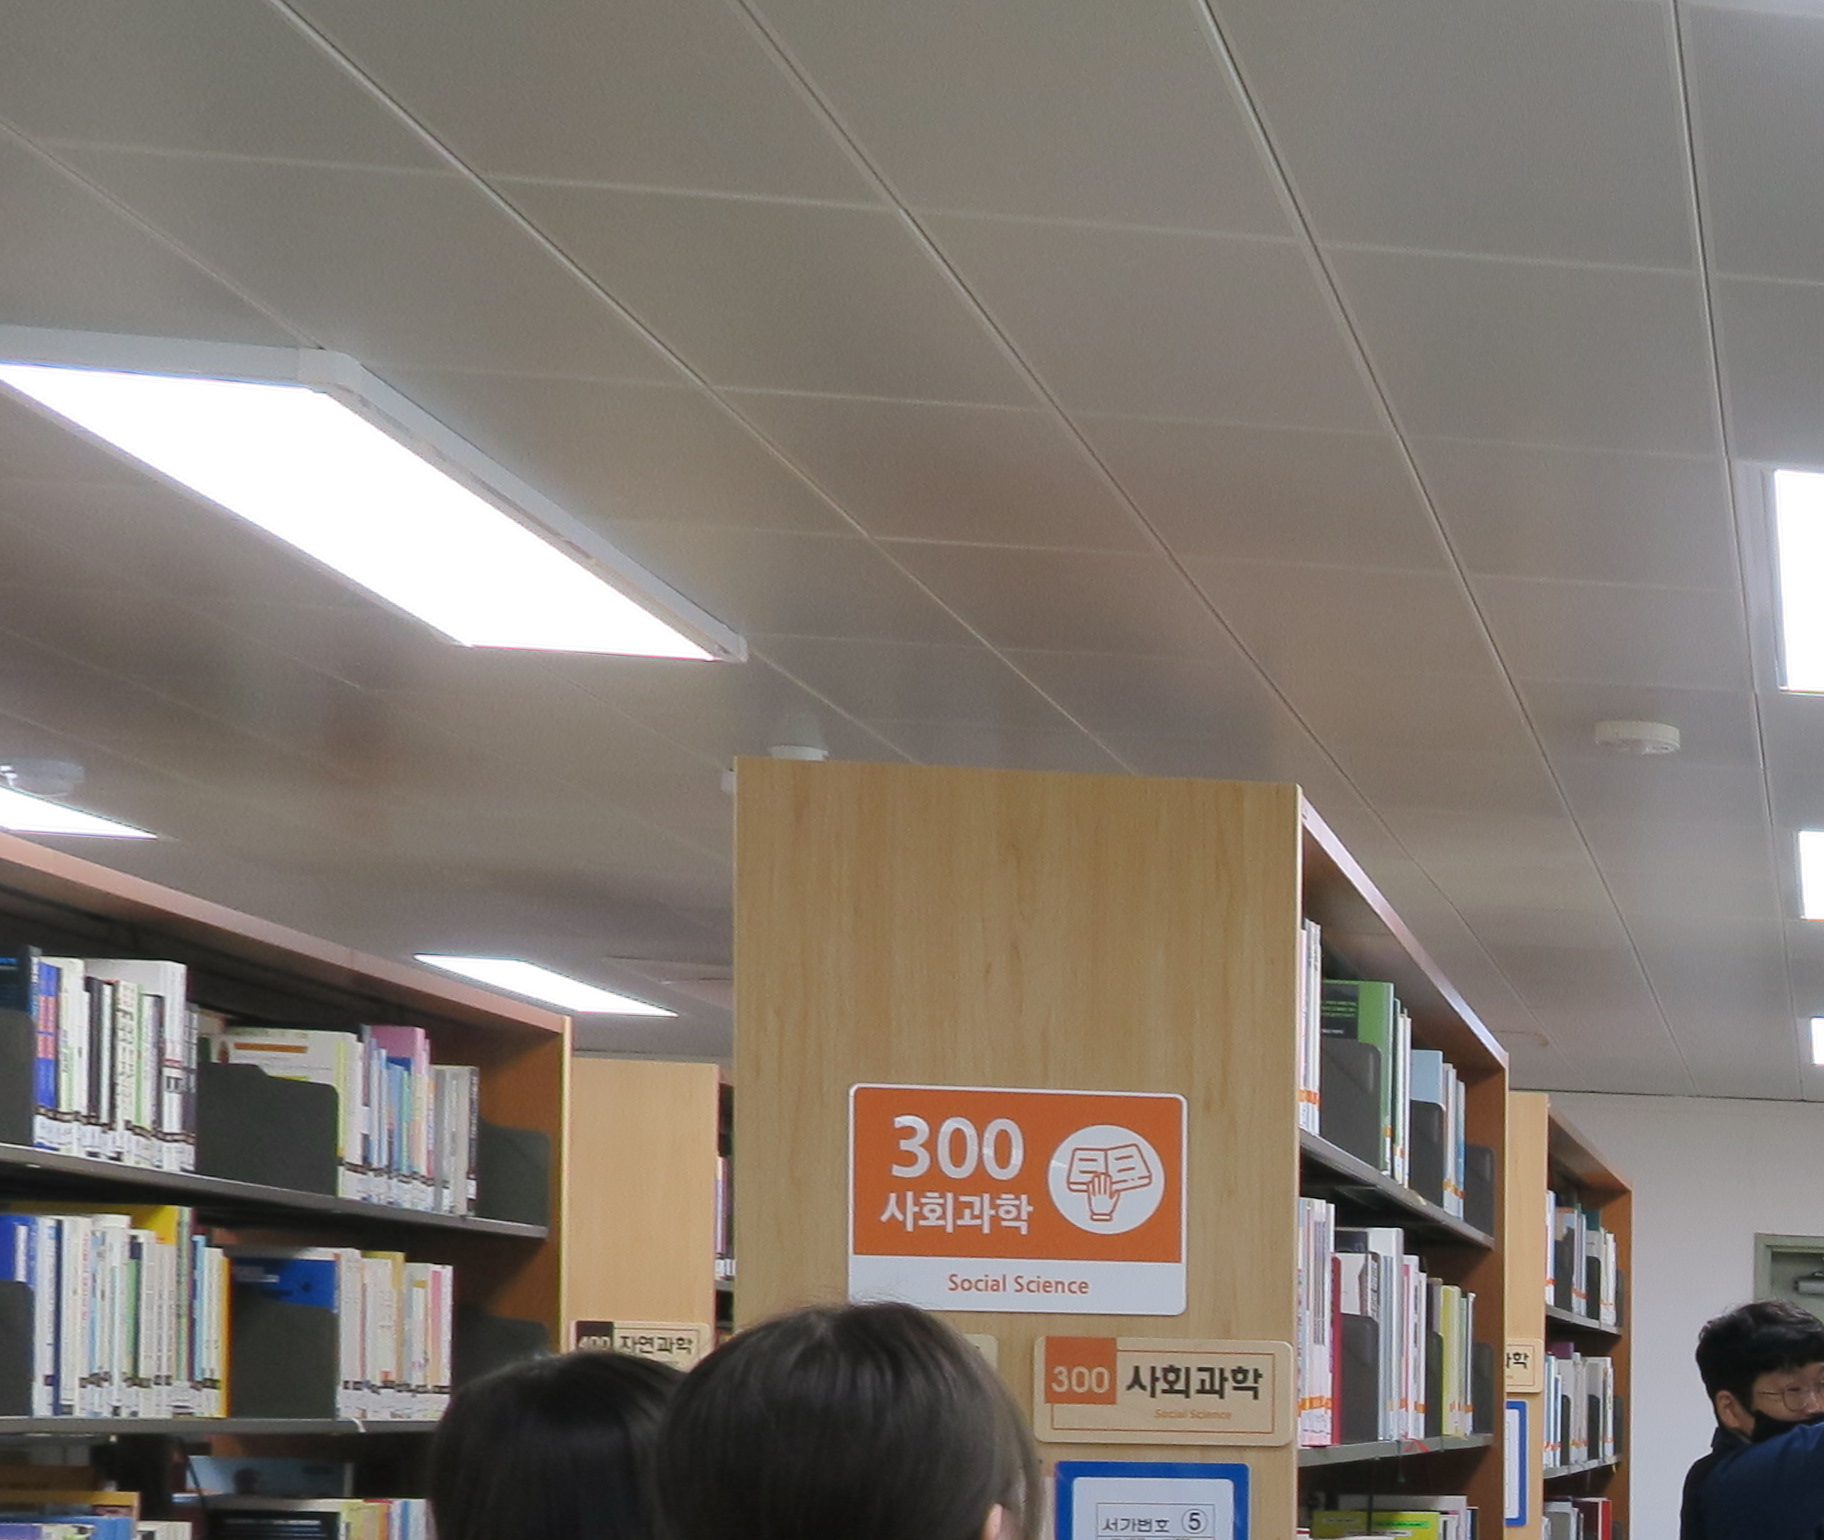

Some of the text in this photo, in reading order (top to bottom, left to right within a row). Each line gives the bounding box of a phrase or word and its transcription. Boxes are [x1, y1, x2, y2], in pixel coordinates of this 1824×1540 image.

[890, 1114, 1025, 1180] 300
[879, 1190, 1033, 1236] 사회과학
[948, 1272, 1089, 1296] Social Science
[620, 1335, 692, 1355] 자연과학
[1051, 1363, 1265, 1400] 300 사회과학
[1102, 1518, 1170, 1533] 서가번호
